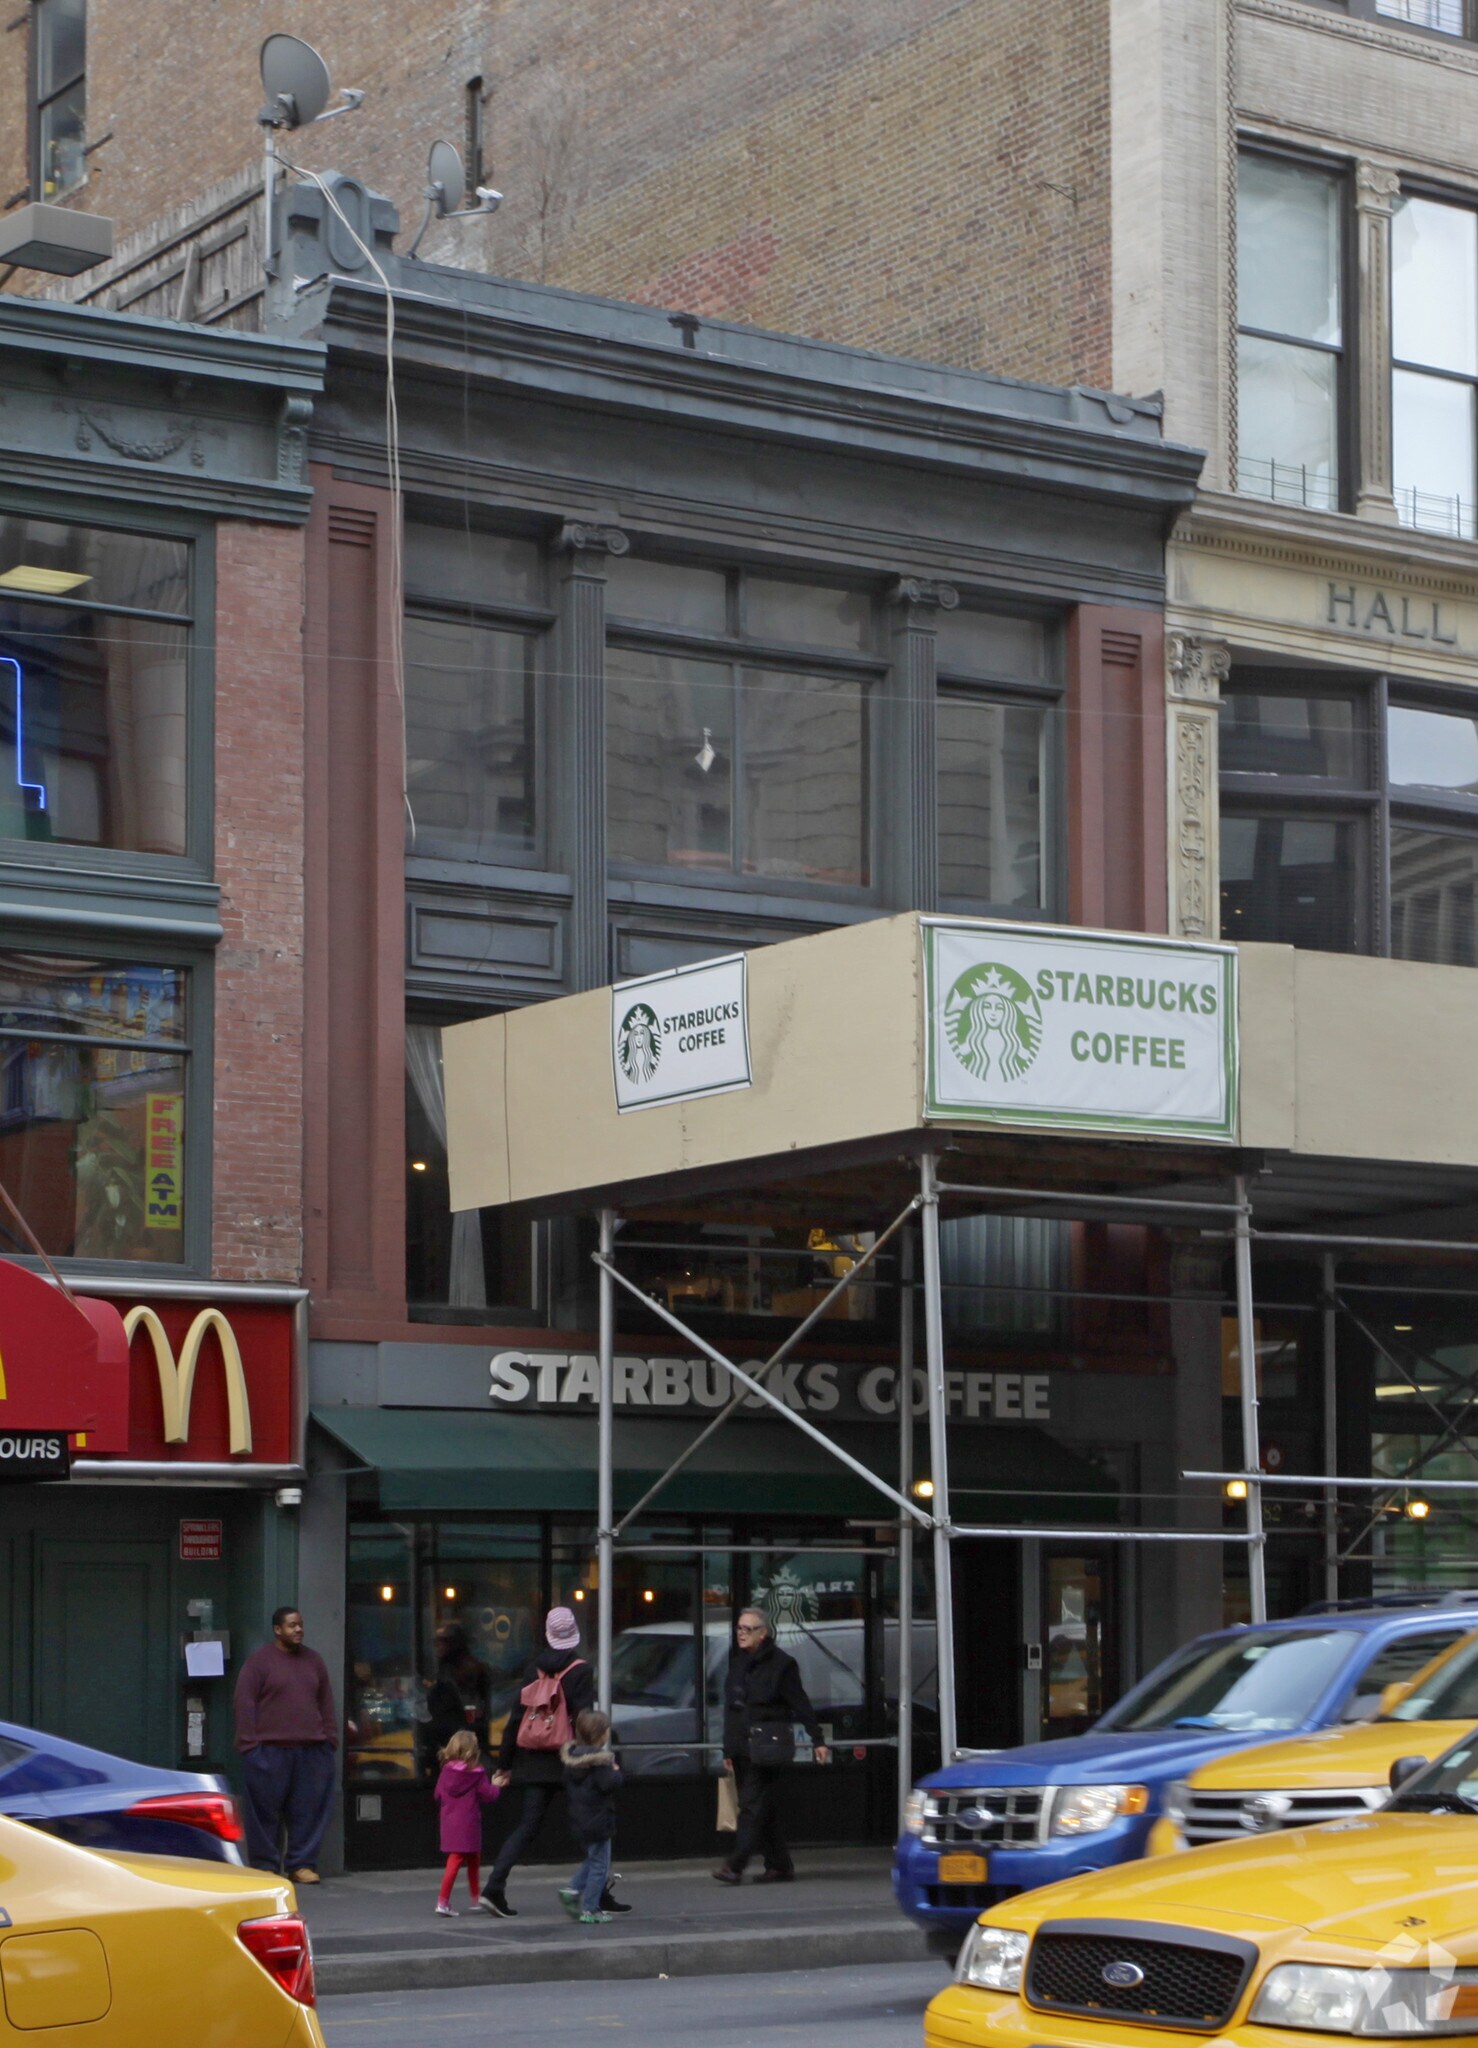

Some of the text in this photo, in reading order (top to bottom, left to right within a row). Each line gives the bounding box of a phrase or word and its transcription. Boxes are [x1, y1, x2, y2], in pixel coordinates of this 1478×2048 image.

[1328, 583, 1456, 644] HALL
[1036, 969, 1217, 1015] STARBUCKS
[663, 1001, 739, 1034] STARBUCKS
[678, 1028, 725, 1053] COFFEE
[1071, 1030, 1186, 1070] COFFEE
[151, 1099, 177, 1168] FREE
[148, 1172, 178, 1216] ATM
[488, 1351, 1051, 1420] STARBUCKS COFFEE
